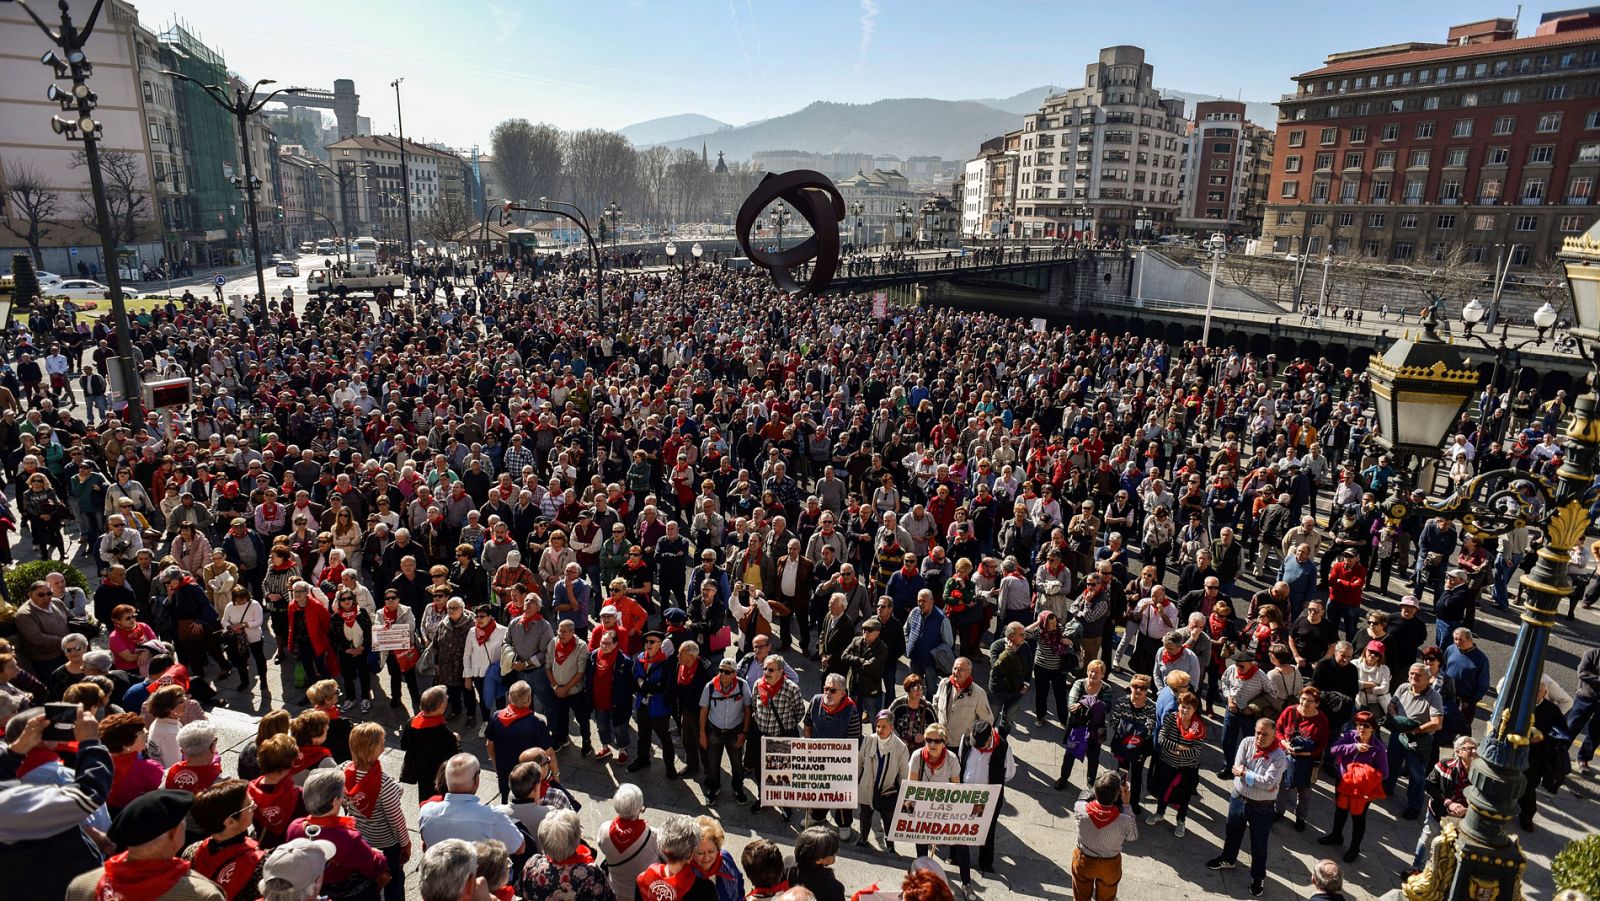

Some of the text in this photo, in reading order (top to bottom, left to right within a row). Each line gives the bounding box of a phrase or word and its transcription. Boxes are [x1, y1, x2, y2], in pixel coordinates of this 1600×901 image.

[792, 742, 806, 750] POR
[792, 763, 825, 771] HIJA/OS
[783, 790, 795, 801] UN
[796, 791, 817, 801] PASO
[904, 785, 990, 804] PENSIONES
[929, 802, 953, 811] LAS
[907, 811, 976, 821] QUEREMOS
[896, 819, 980, 836] BLINDADAS
